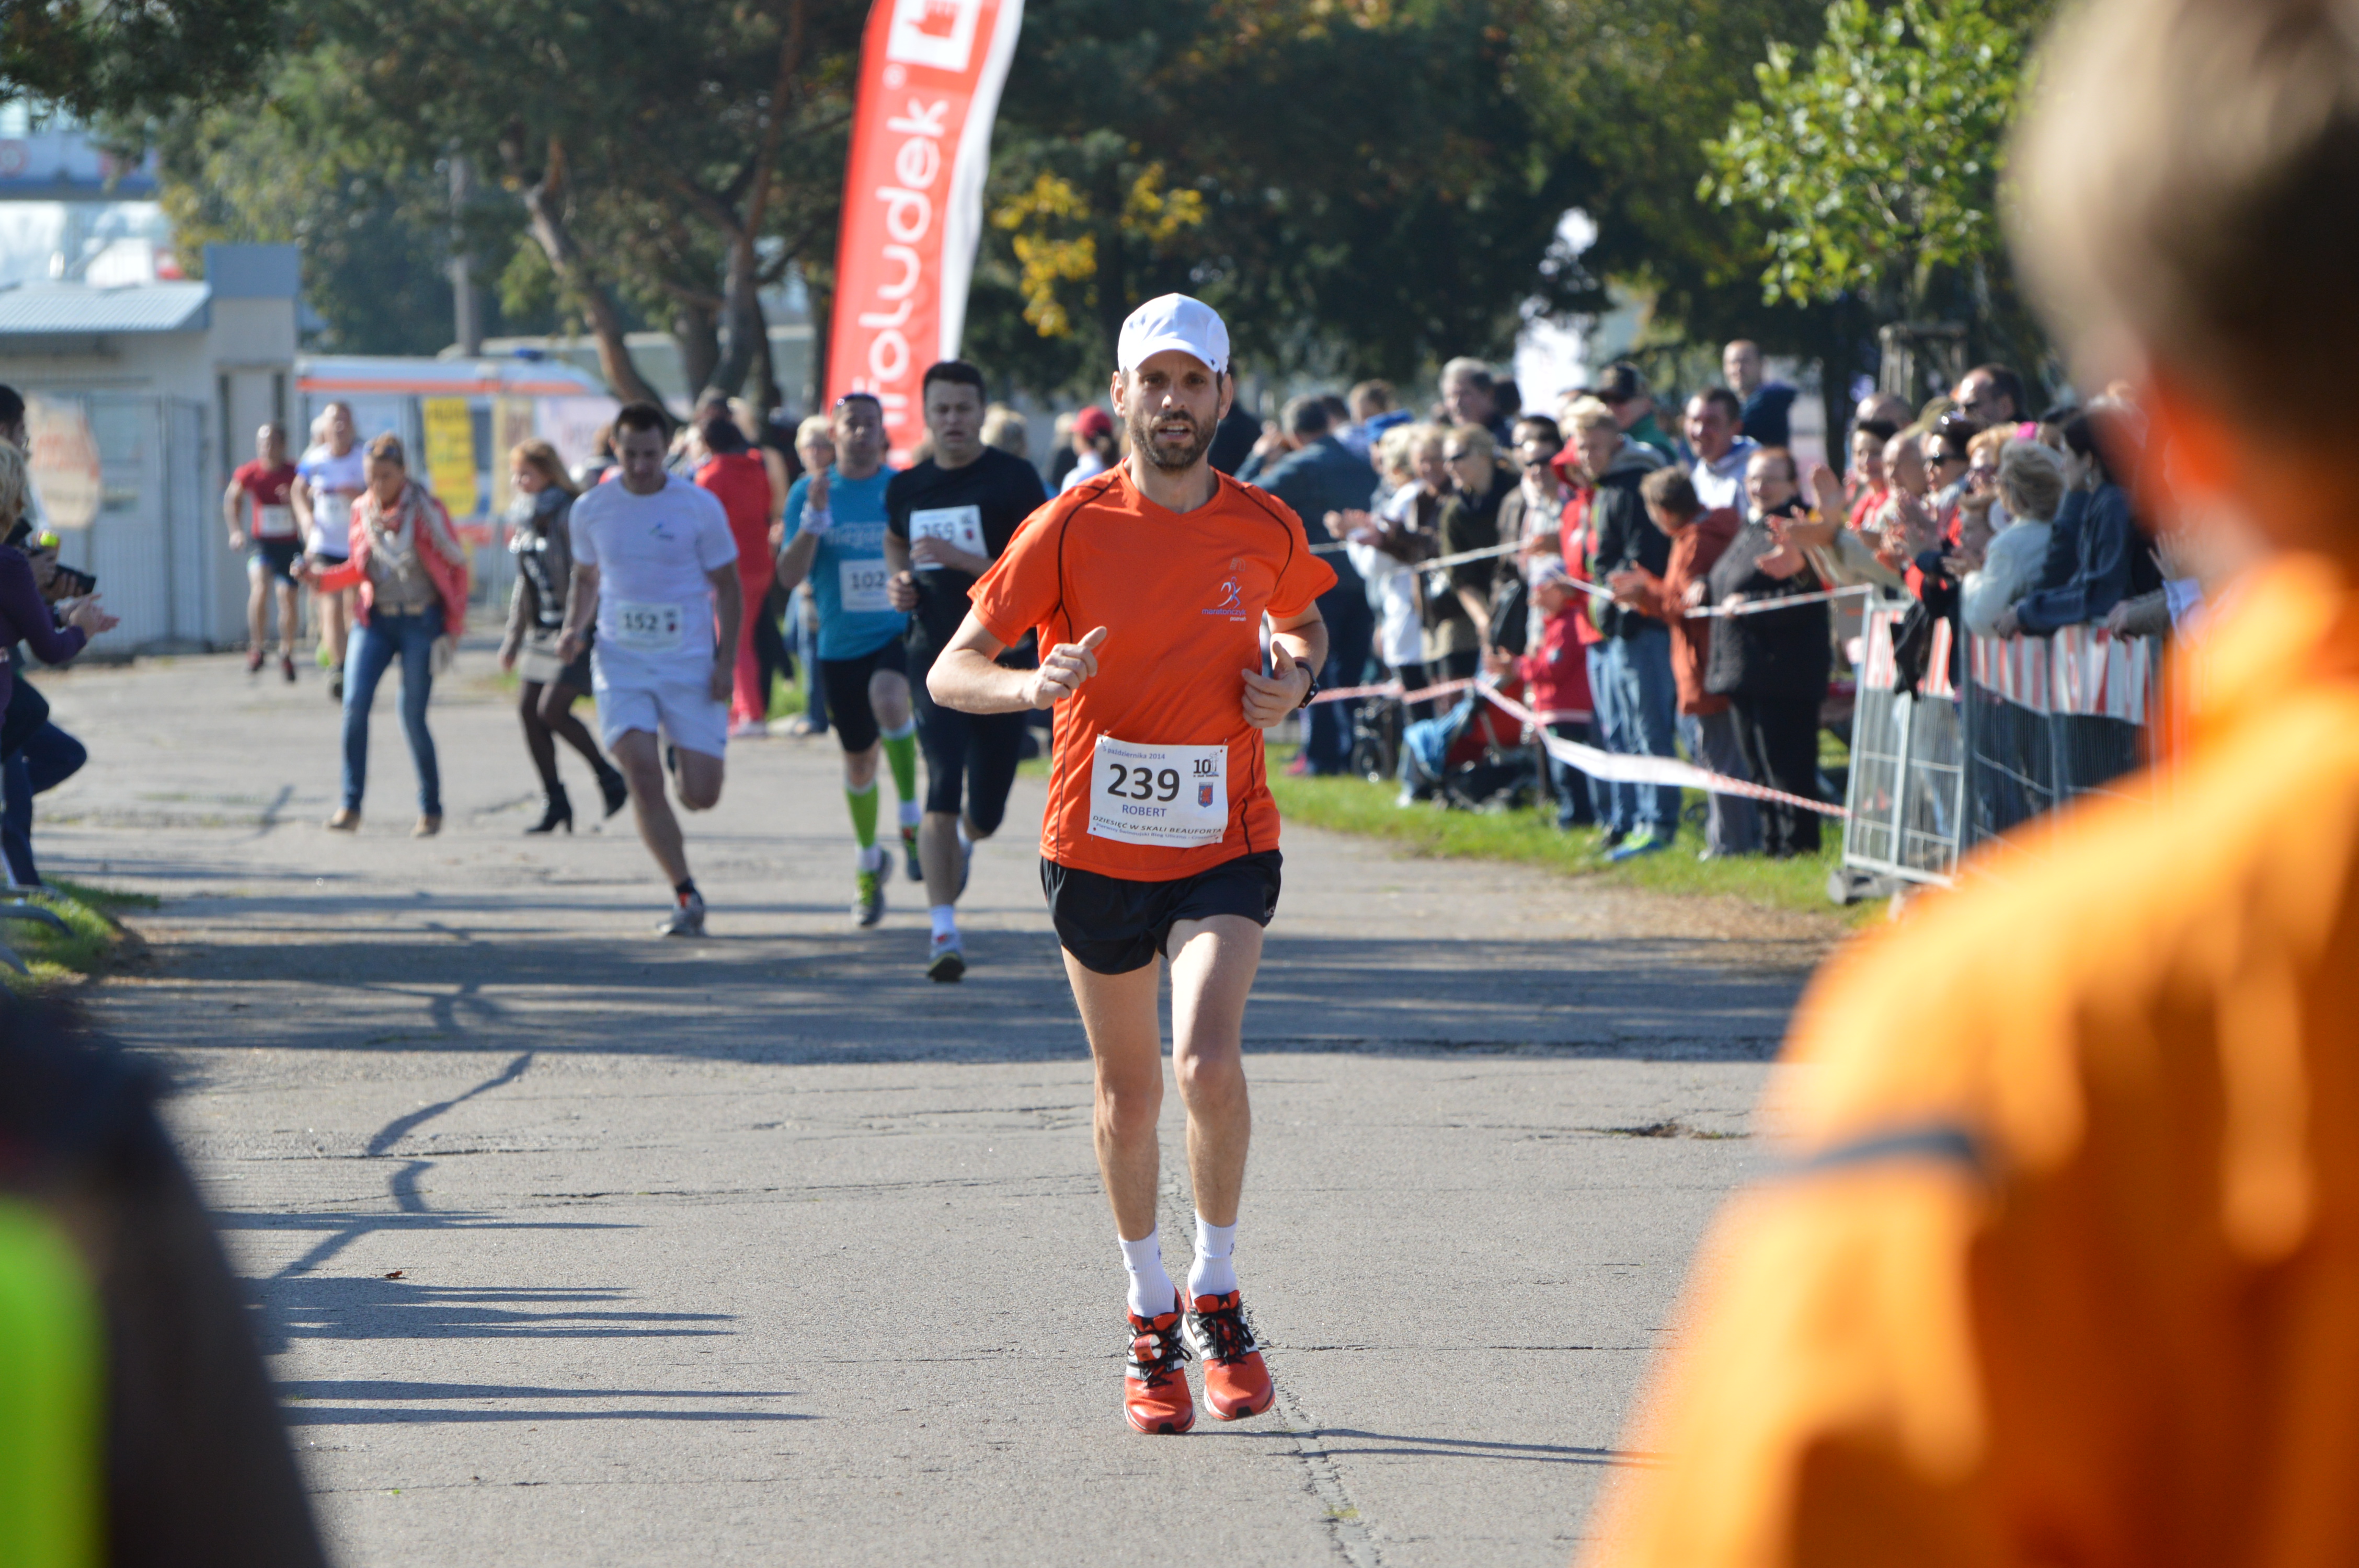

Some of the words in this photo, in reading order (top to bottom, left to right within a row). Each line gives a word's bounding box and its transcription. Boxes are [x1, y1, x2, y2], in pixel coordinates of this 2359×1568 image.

[851, 571, 885, 590] 102
[623, 612, 658, 631] 152
[1193, 759, 1211, 774] 10
[1107, 764, 1180, 802] 239
[1122, 804, 1167, 817] ROBERT
[1093, 815, 1128, 828] DZIESIĘĆ
